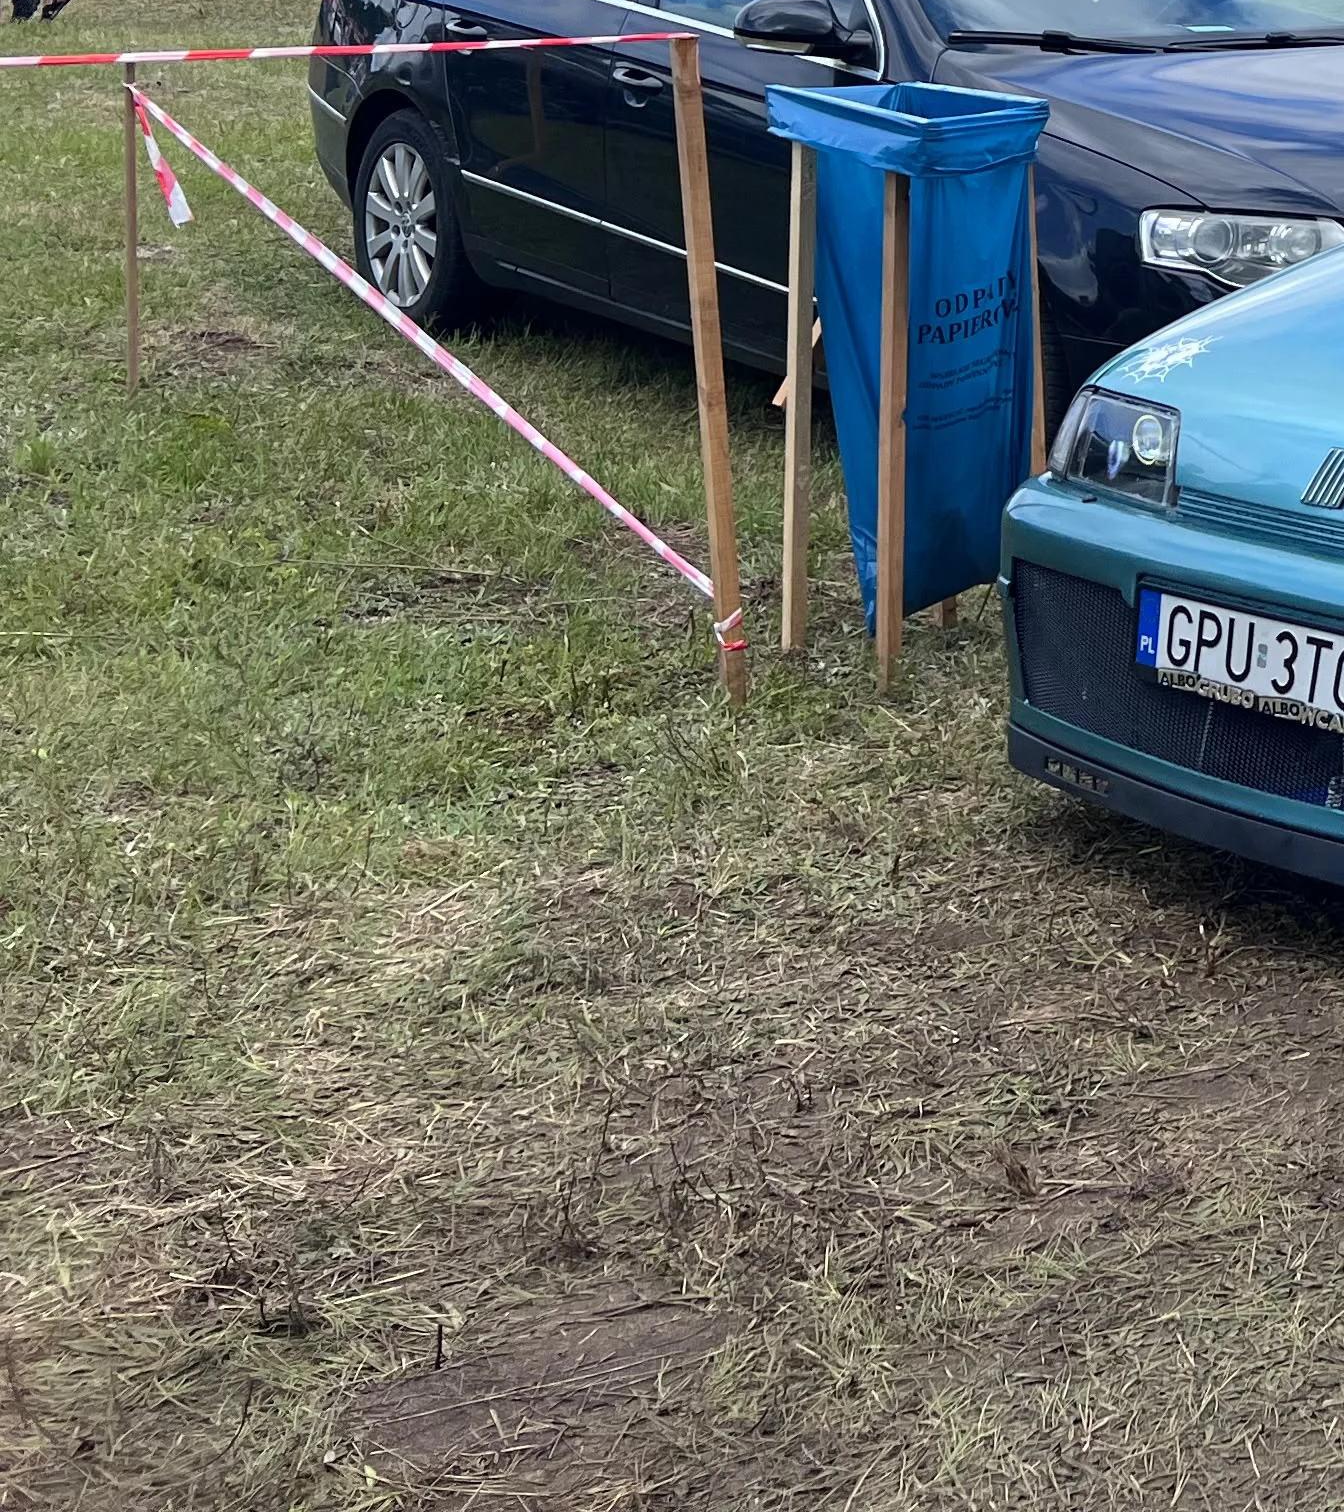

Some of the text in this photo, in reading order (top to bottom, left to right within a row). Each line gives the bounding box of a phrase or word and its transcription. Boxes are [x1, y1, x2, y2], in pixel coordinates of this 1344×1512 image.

[1139, 635, 1155, 654] PL
[1166, 604, 1255, 683] GPU
[1159, 672, 1196, 689] ALBO
[1198, 678, 1256, 709] GRUBO
[1260, 700, 1300, 717] ALBO
